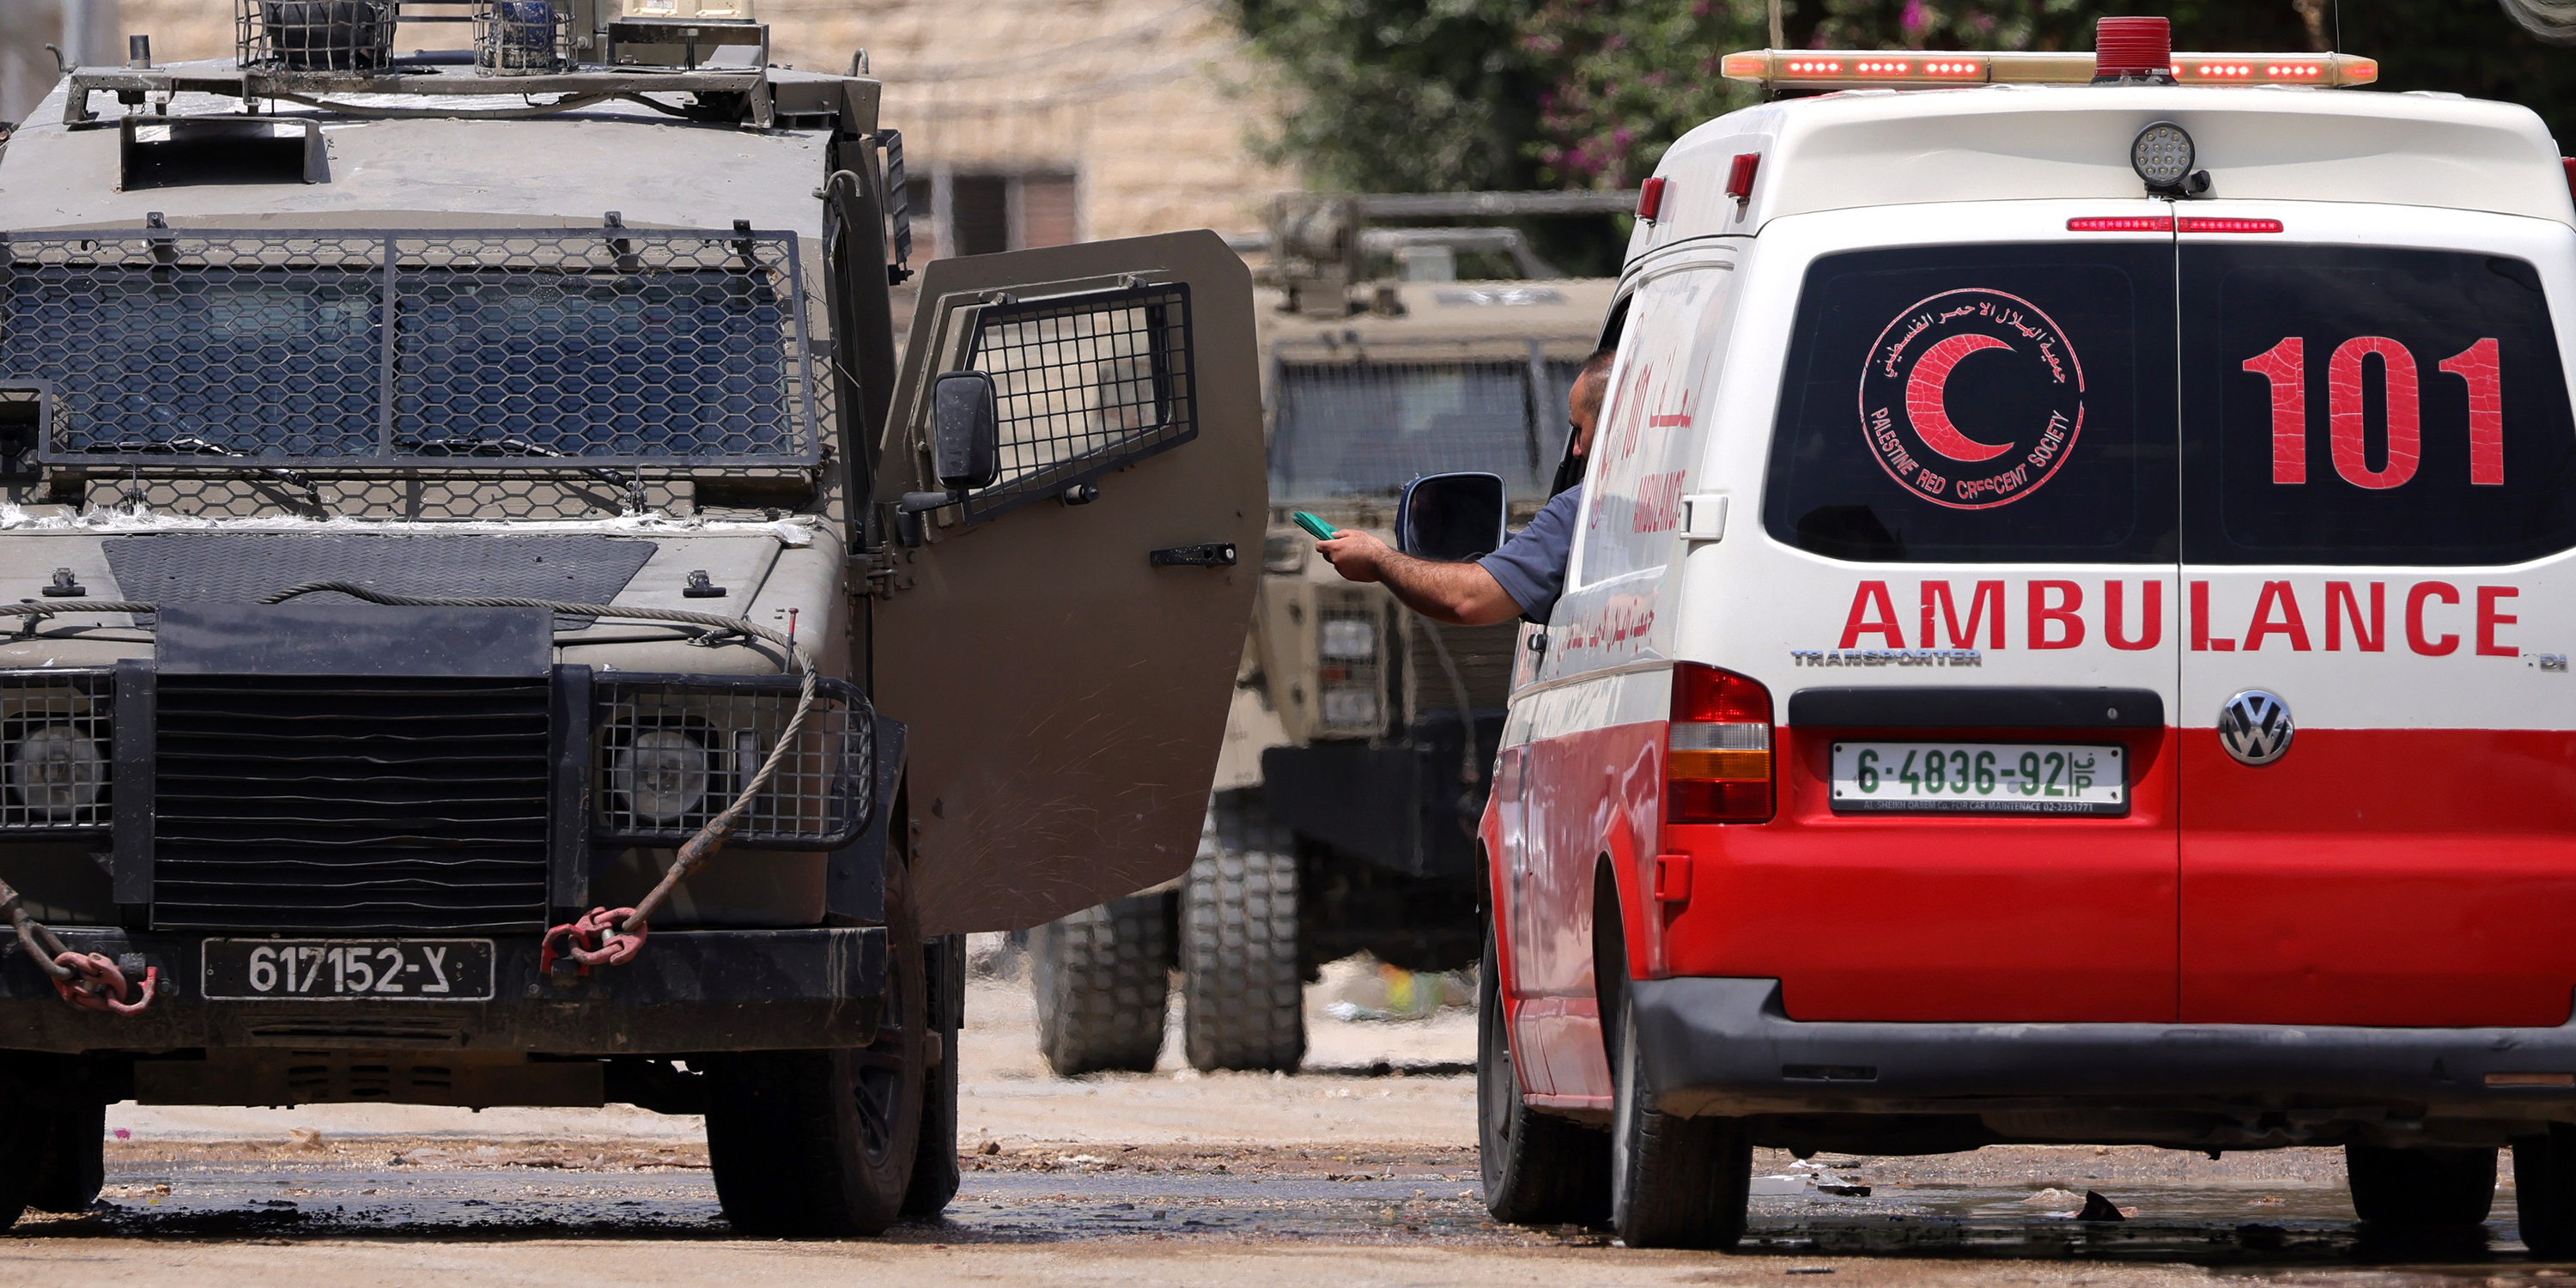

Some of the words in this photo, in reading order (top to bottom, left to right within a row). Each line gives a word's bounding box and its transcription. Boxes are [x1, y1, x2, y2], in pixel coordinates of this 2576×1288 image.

[1996, 307, 2047, 341] الهلال
[2040, 337, 2066, 384] جمعية
[2241, 336, 2506, 489] 101
[1870, 407, 1920, 476] PALESTINE
[1916, 468, 1947, 495] RED
[2027, 409, 2070, 467] SOCIETY
[1632, 469, 1686, 533] AMBULANCE
[1838, 579, 2519, 658] AMBULANCE
[1791, 649, 1982, 667] TRANSPORTER
[1952, 800, 1968, 810] FOR
[1970, 801, 1985, 810] CAR
[1989, 801, 2040, 811] MAINTENACE
[2044, 802, 2093, 811] 02-2351771
